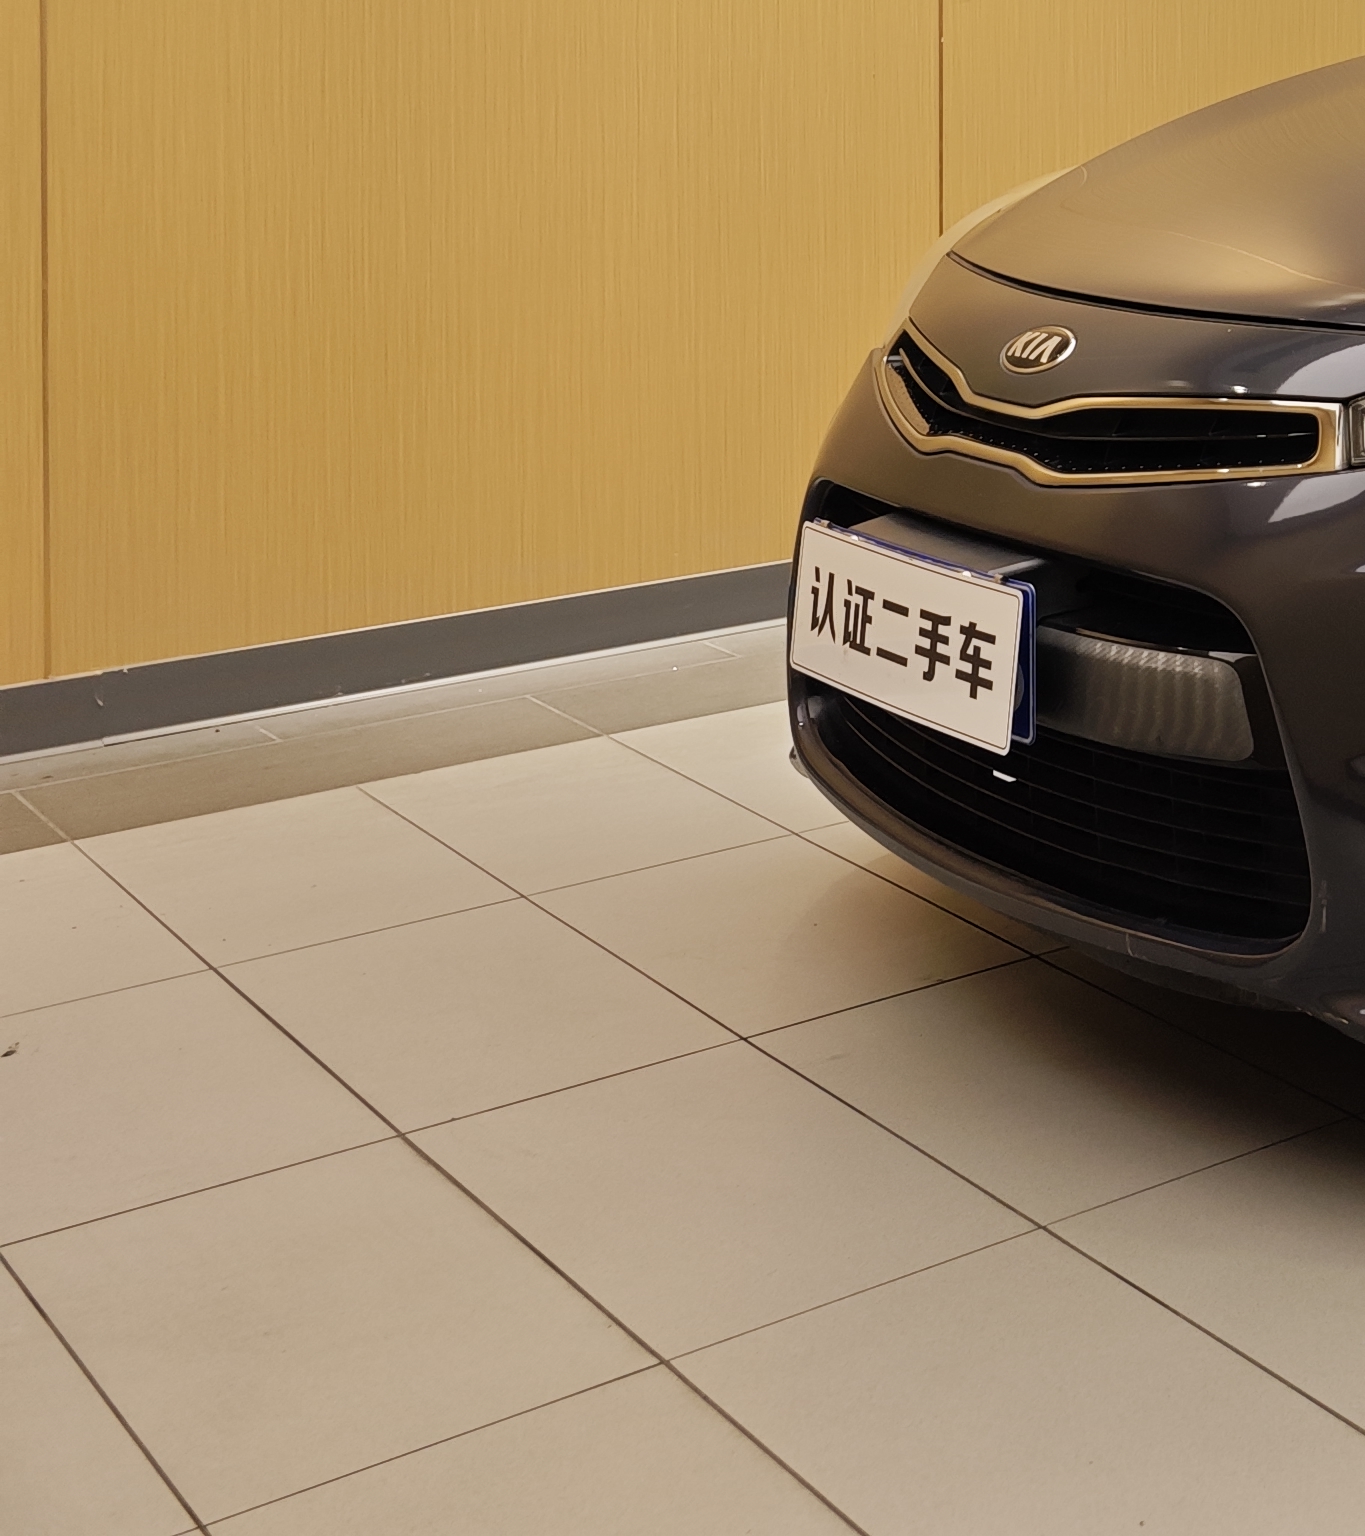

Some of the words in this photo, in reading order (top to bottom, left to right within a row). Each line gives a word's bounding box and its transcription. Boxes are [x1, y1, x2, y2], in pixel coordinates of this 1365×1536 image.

[1006, 331, 1062, 363] KIA
[810, 566, 996, 700] 认证二手车
